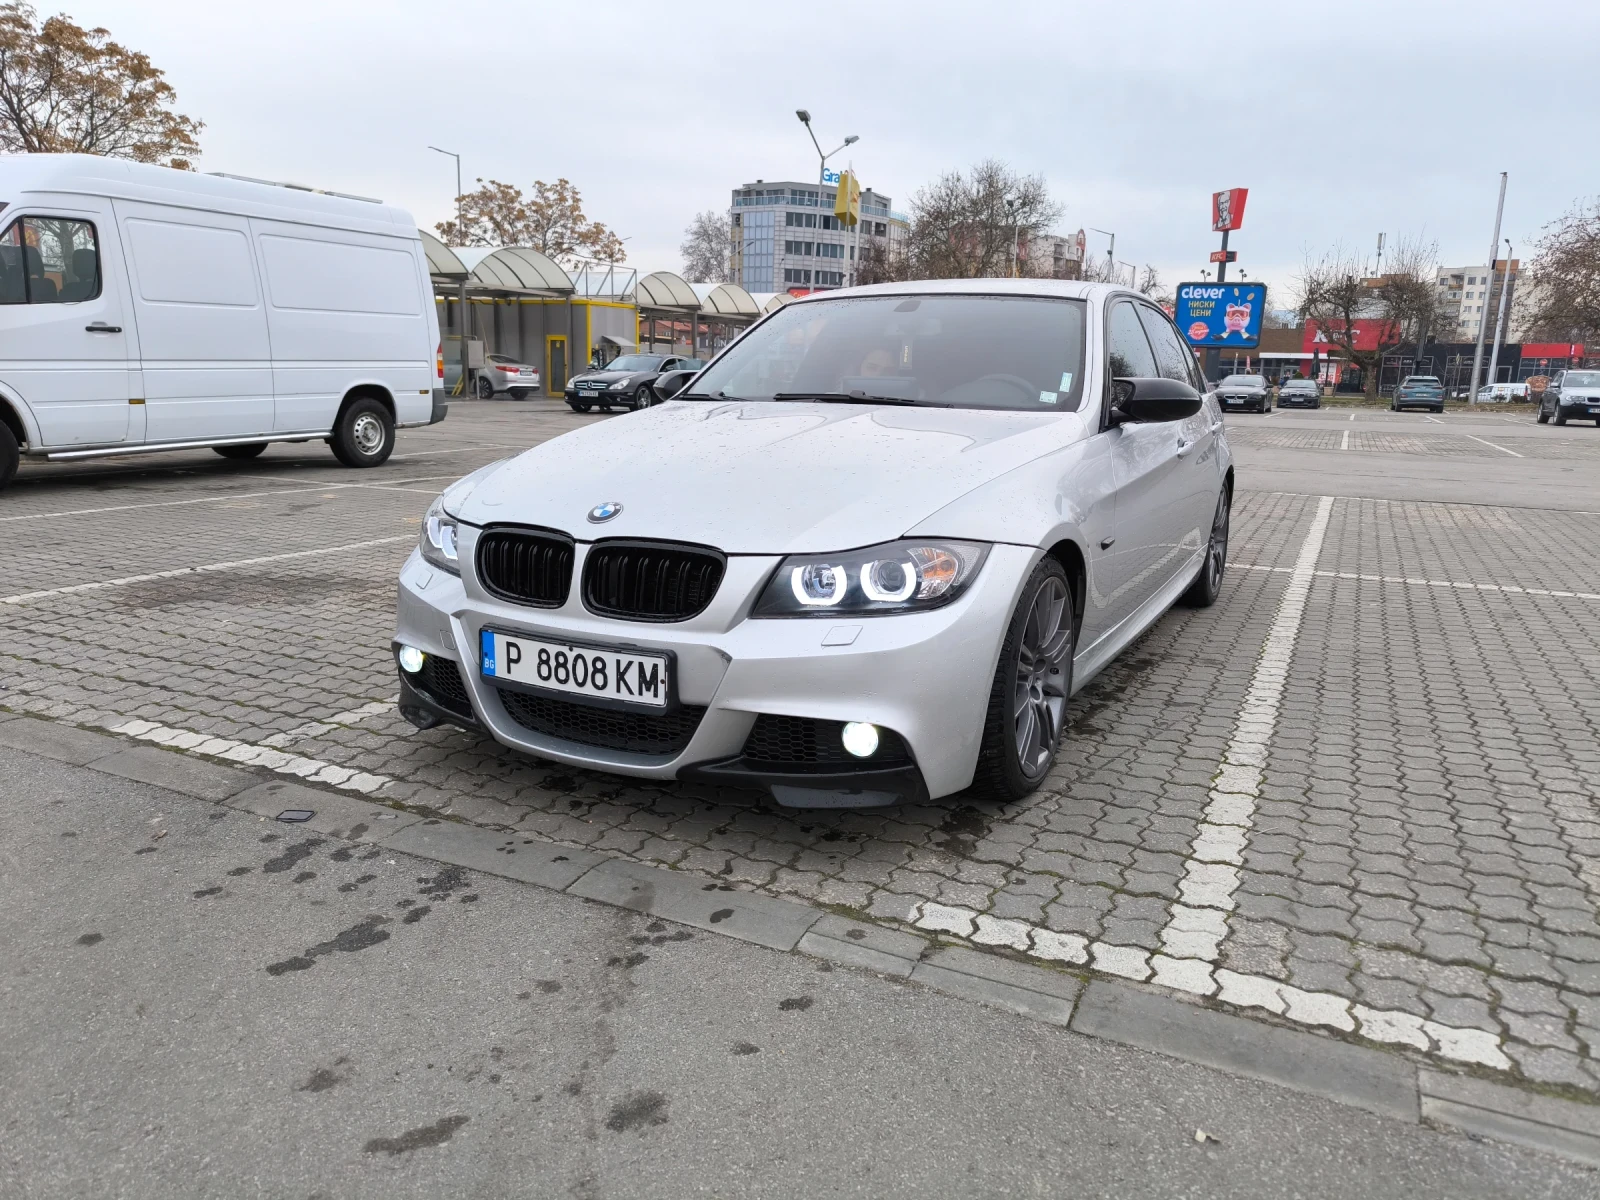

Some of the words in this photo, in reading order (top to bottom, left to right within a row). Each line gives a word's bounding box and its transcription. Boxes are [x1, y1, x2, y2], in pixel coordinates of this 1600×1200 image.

[822, 168, 842, 183] Gra
[1211, 252, 1223, 260] KFC
[1181, 286, 1225, 299] clever
[1188, 301, 1215, 309] НИСКИ
[1190, 309, 1211, 317] ЦЕНИ
[484, 657, 494, 669] BG
[505, 640, 522, 675] P
[537, 647, 608, 691] 8808
[615, 658, 659, 698] KM
